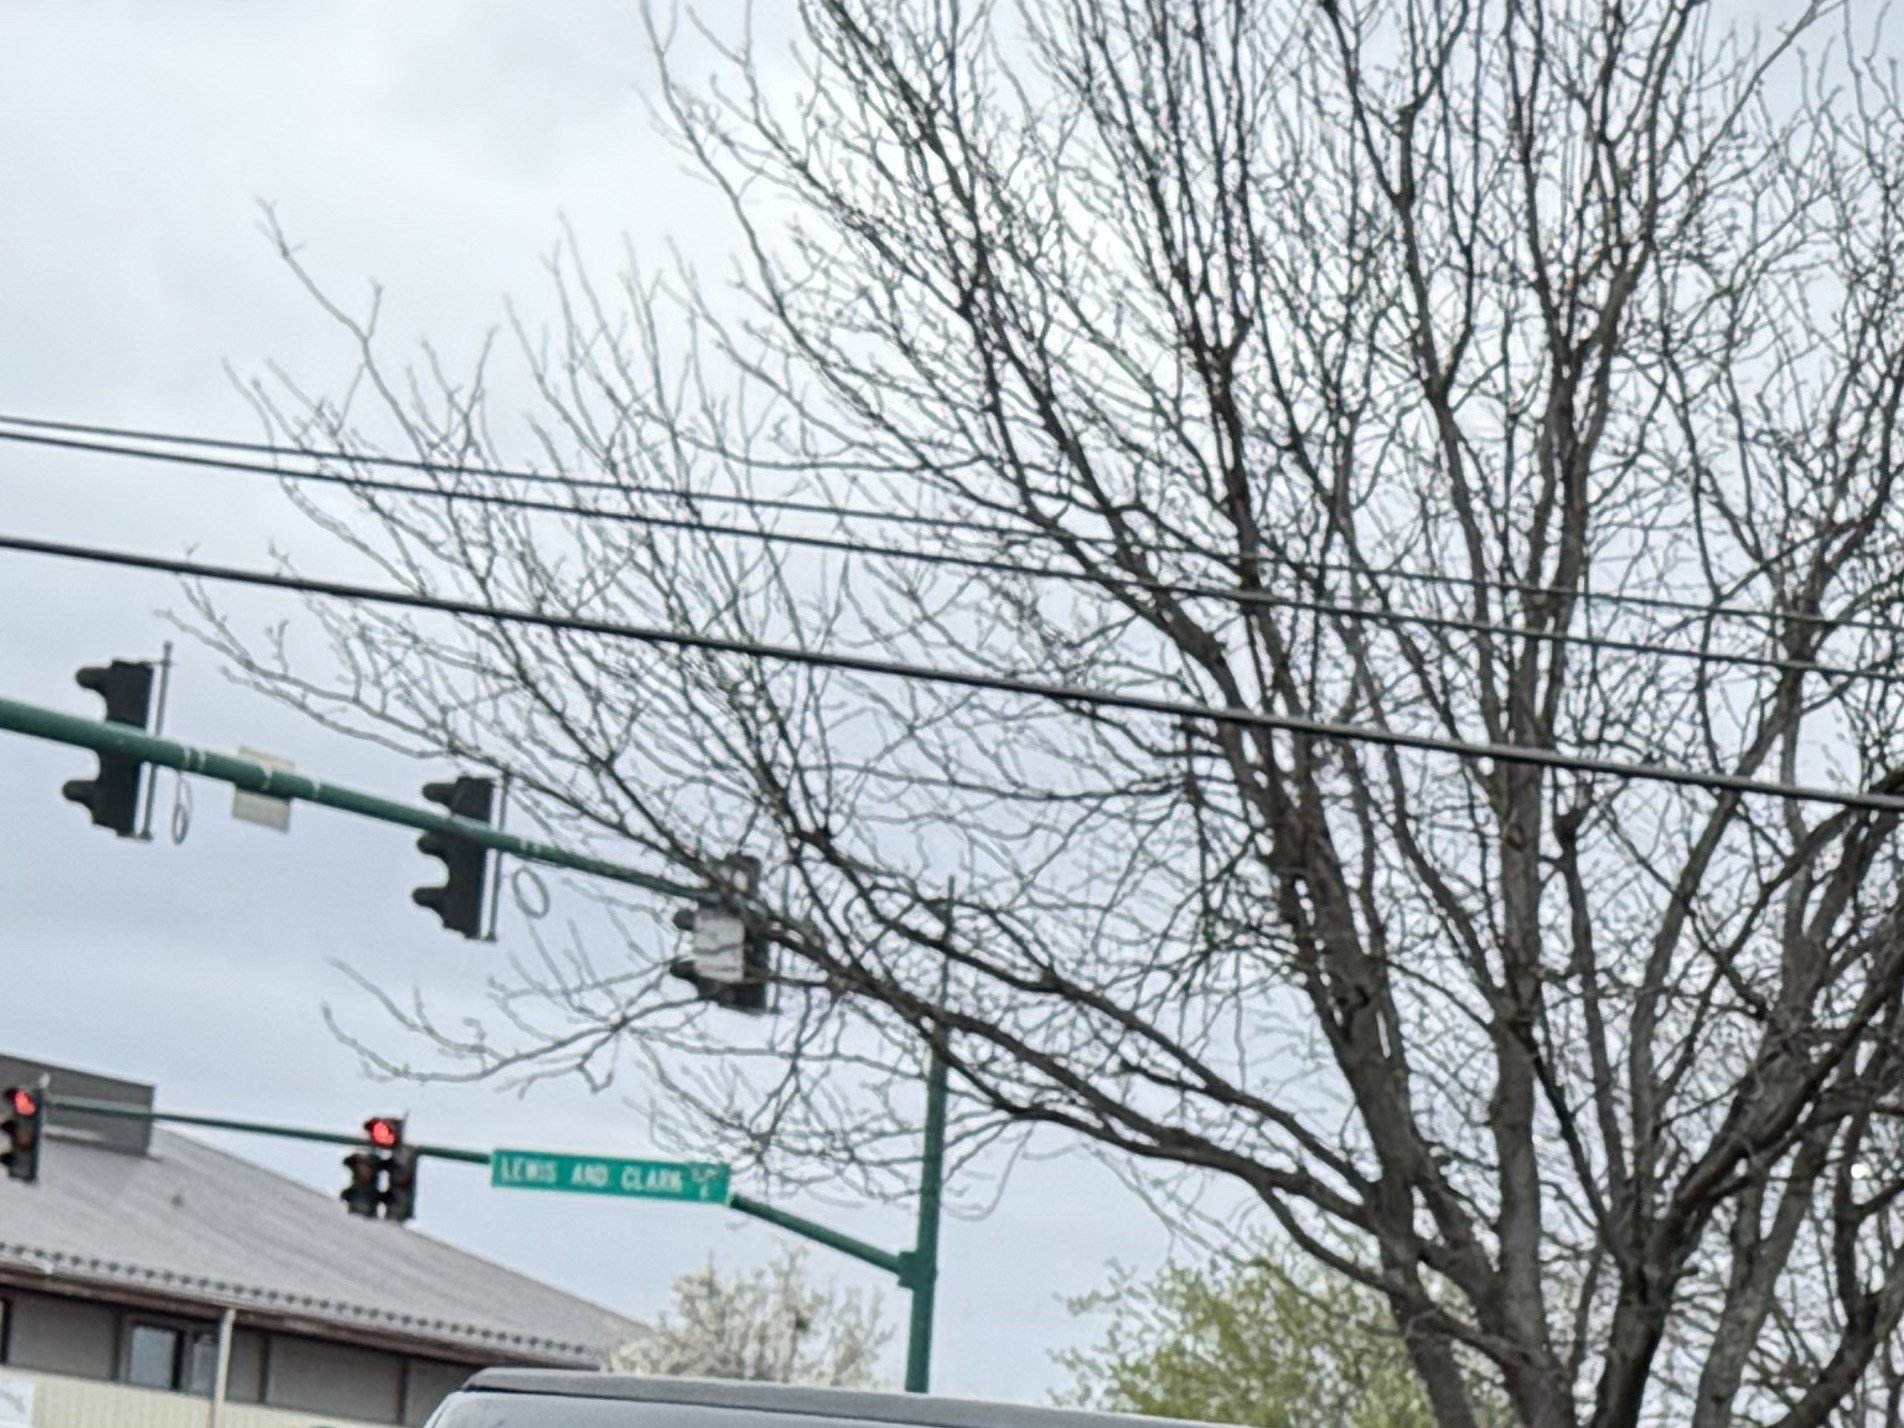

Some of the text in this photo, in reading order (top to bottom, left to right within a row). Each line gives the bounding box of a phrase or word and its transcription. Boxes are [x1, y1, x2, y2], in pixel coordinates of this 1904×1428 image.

[503, 1157, 556, 1183] LEWIS
[572, 1163, 608, 1187] AND
[621, 1166, 682, 1192] CLARK
